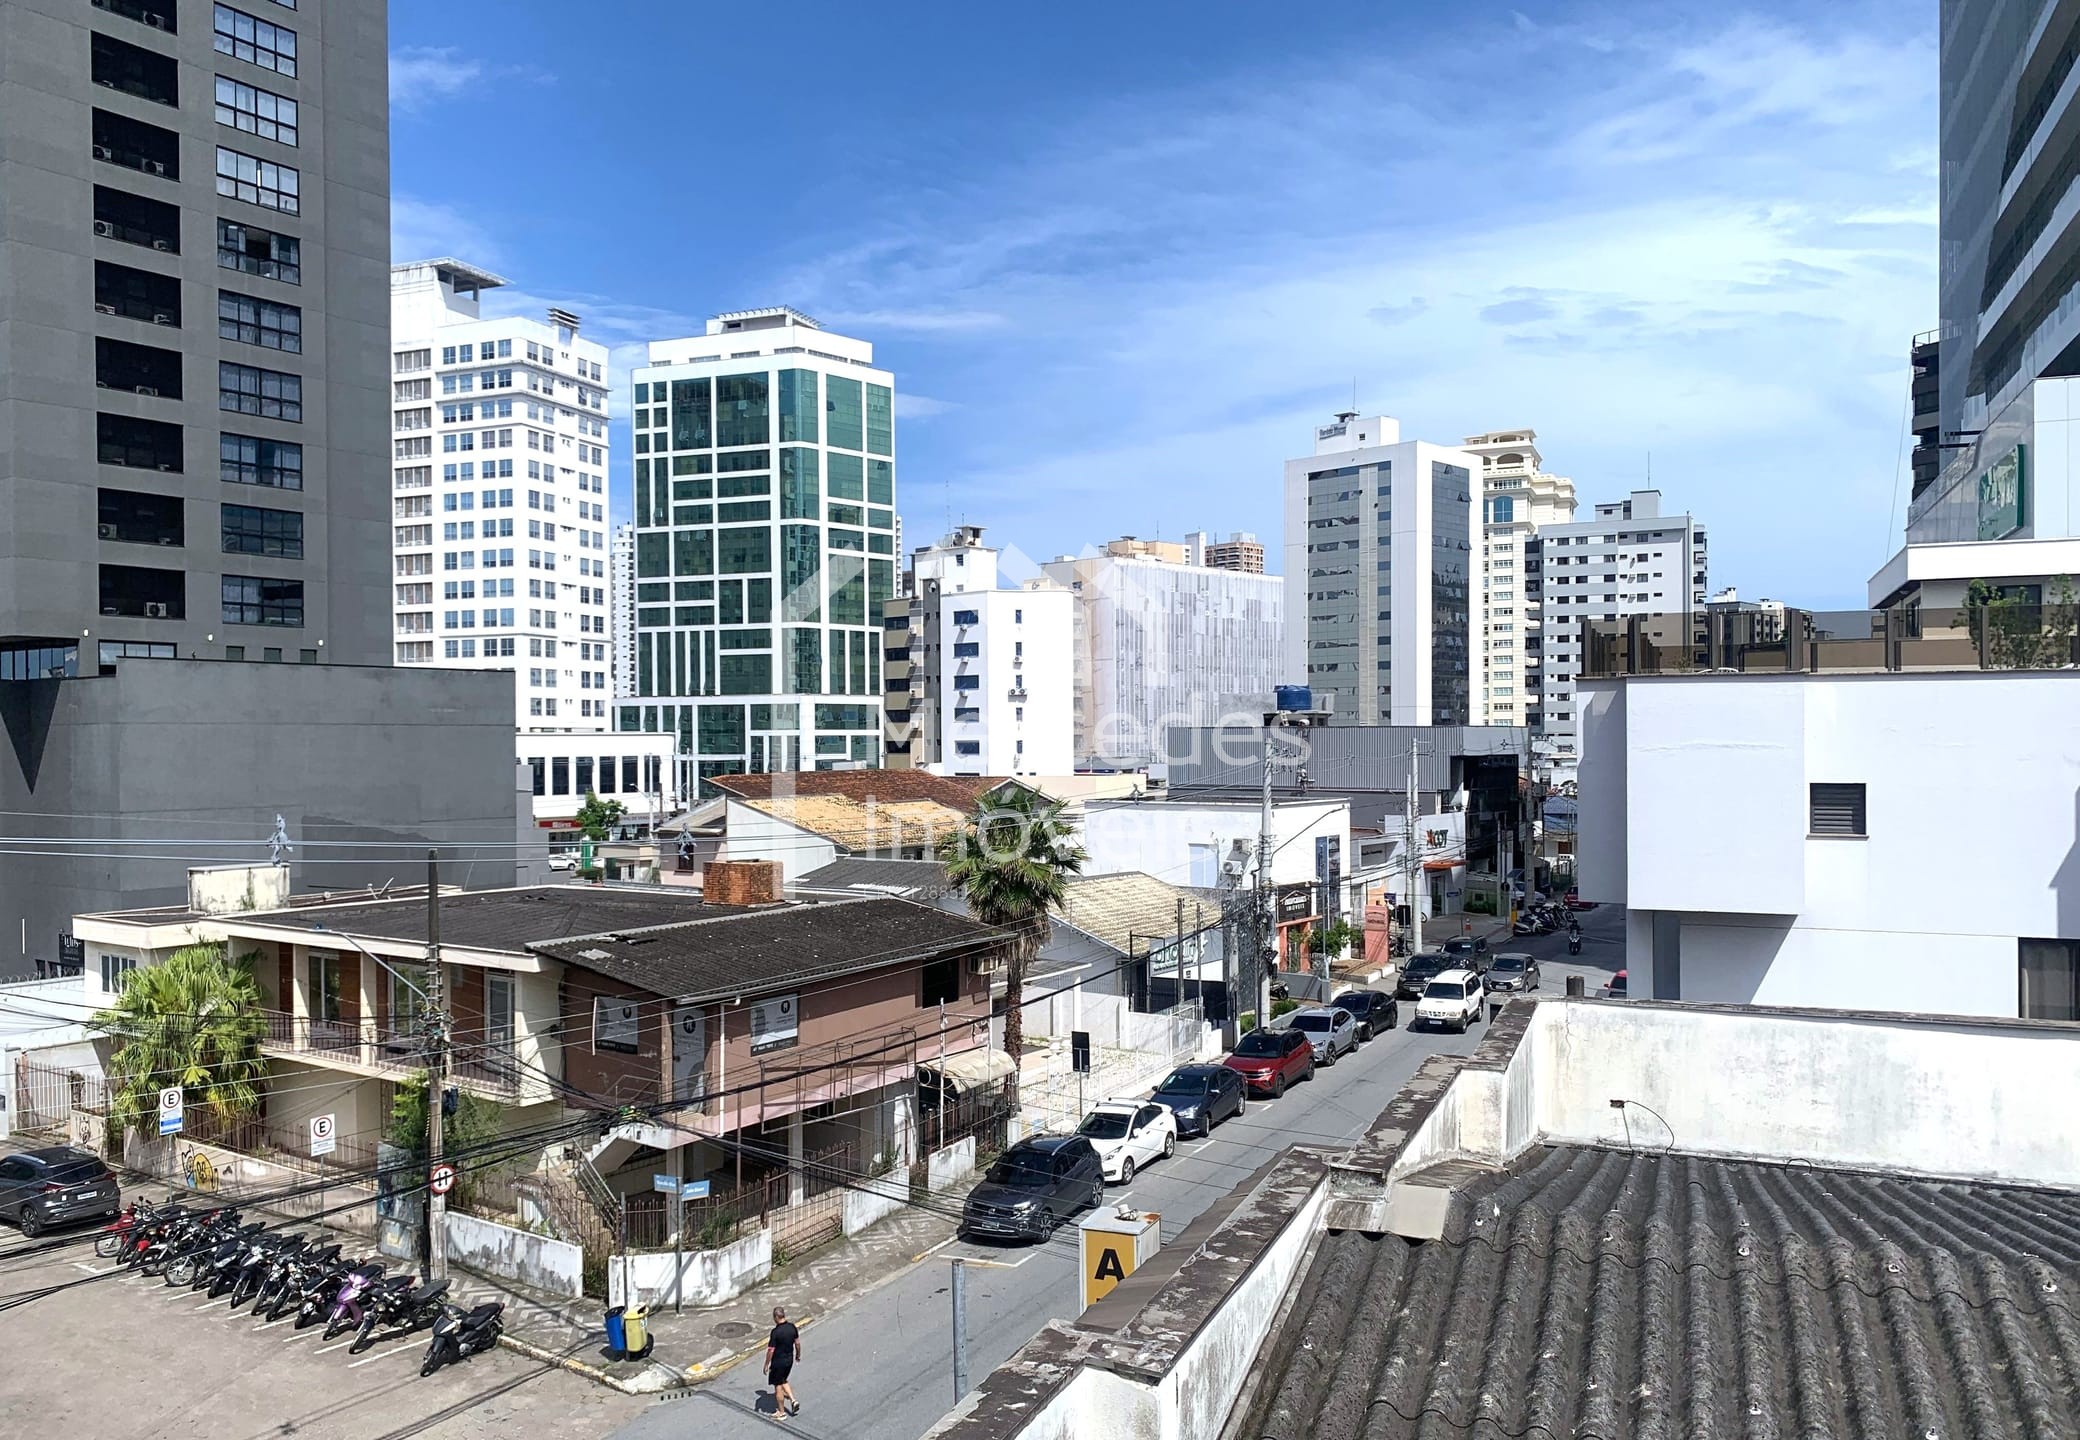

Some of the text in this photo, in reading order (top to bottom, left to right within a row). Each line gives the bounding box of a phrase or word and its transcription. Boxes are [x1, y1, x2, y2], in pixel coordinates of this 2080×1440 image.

[168, 1093, 175, 1105] E
[318, 1121, 327, 1134] E
[1094, 1248, 1125, 1282] A
